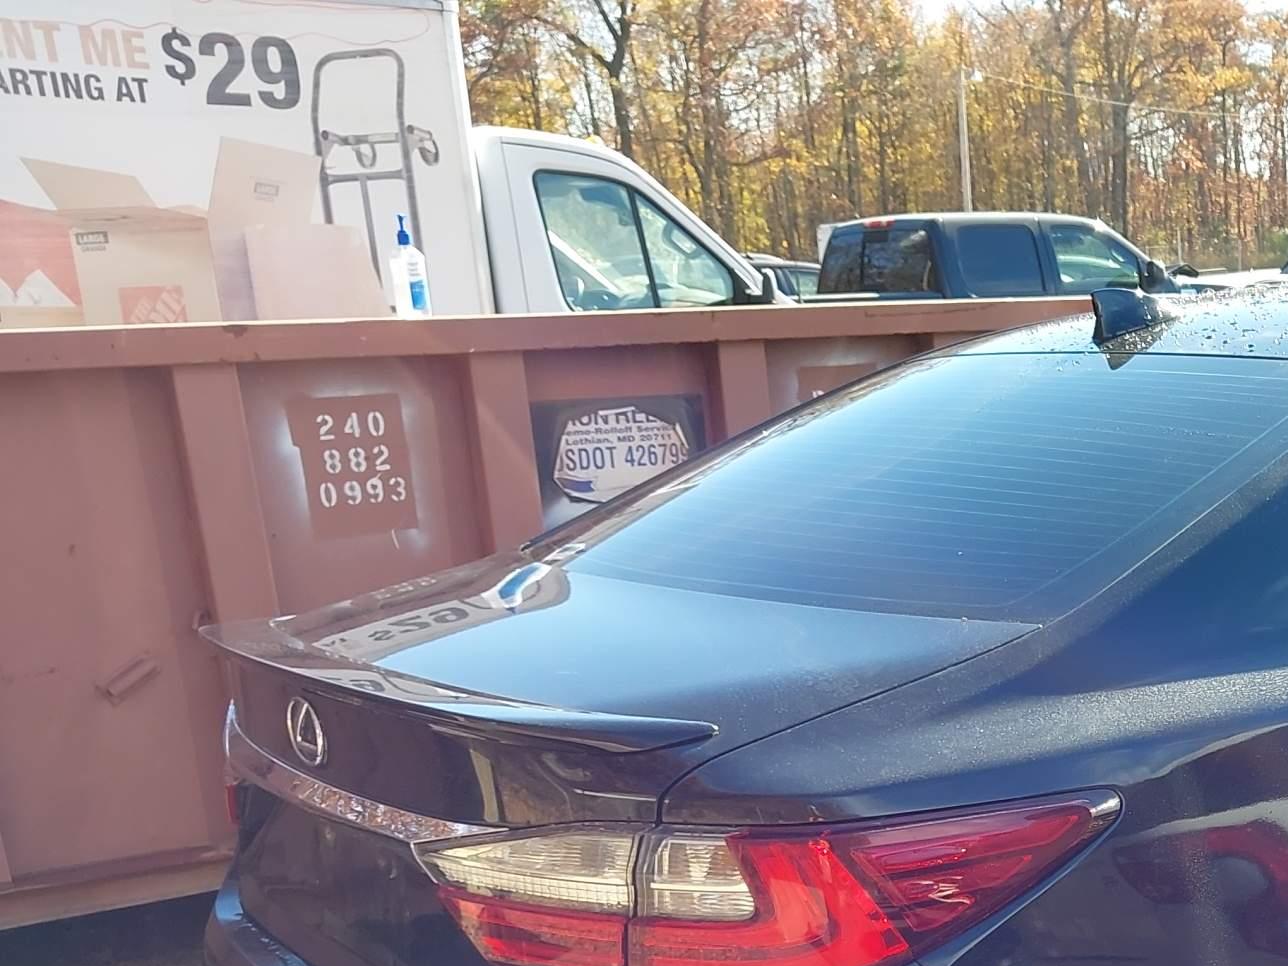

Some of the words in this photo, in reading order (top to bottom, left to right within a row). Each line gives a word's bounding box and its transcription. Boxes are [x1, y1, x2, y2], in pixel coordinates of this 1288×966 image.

[0, 19, 61, 62] NT
[78, 25, 150, 70] ME
[161, 27, 301, 110] $29
[116, 76, 148, 103] AT
[316, 411, 385, 440] 240
[617, 435, 635, 443] MD
[640, 433, 672, 442] 20711
[323, 444, 391, 474] 882
[319, 476, 406, 508] 0993
